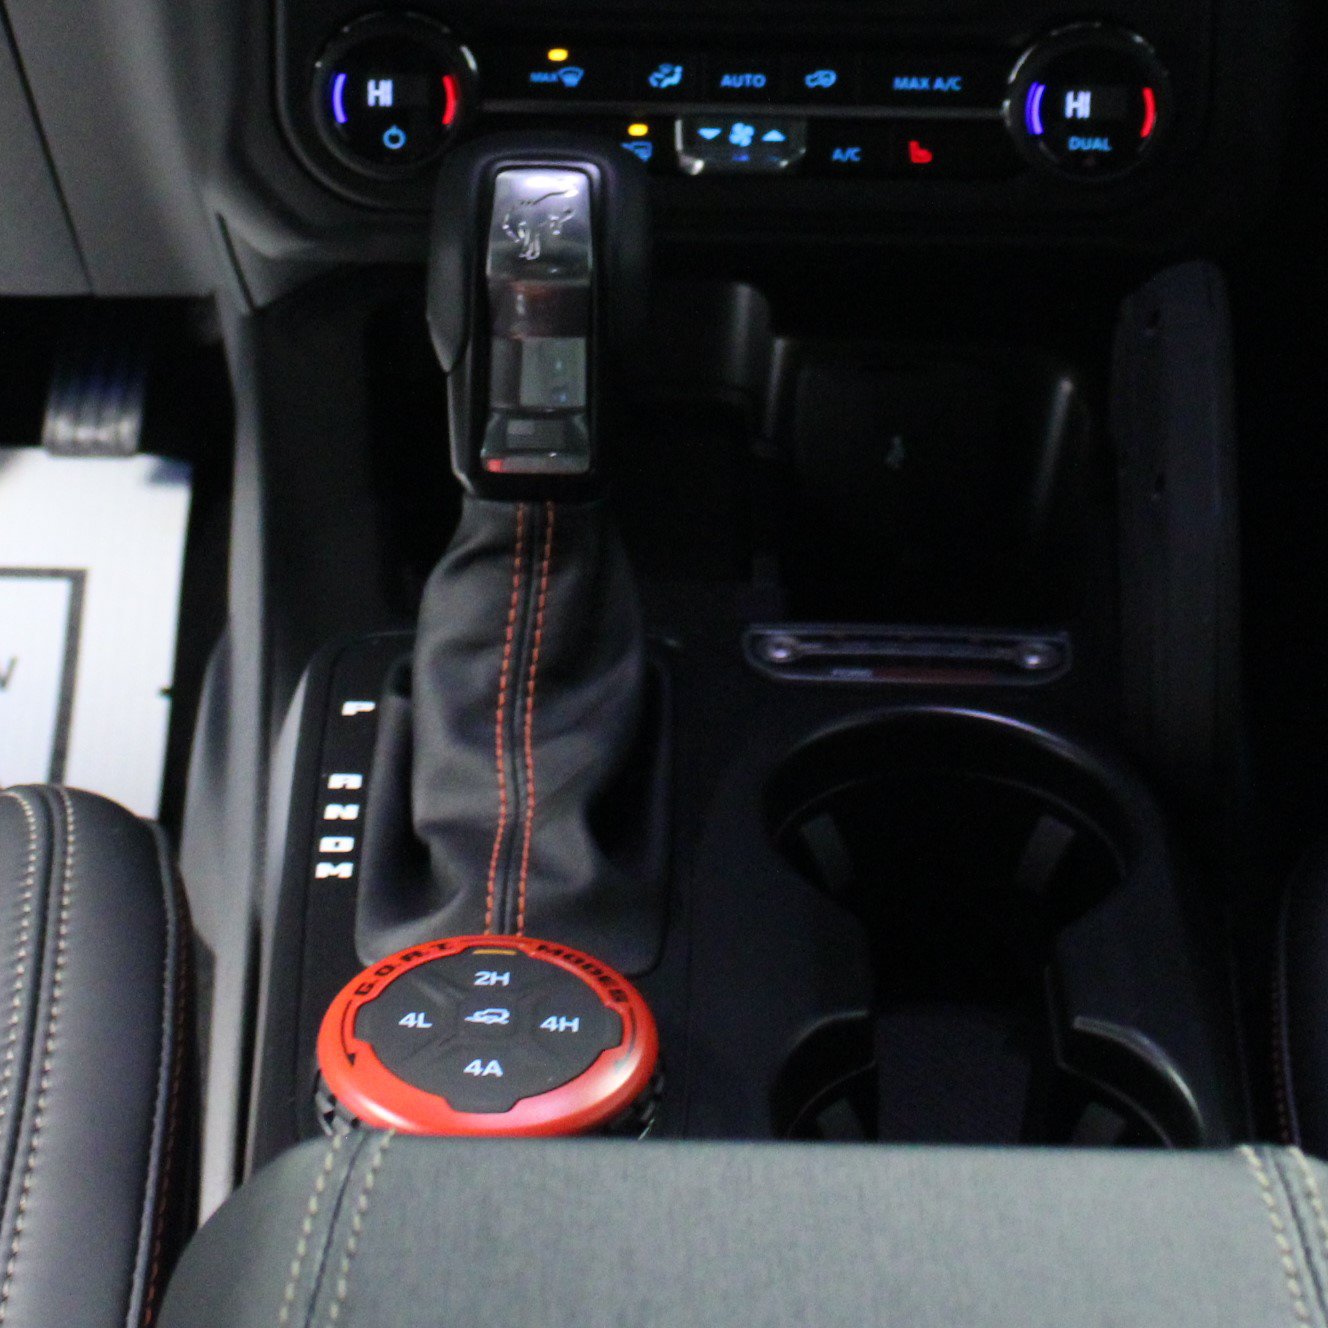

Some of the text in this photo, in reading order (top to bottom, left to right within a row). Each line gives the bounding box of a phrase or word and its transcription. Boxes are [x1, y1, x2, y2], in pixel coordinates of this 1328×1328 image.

[721, 74, 766, 89] AUTO
[893, 76, 962, 92] MAX A/C
[367, 79, 393, 107] HI
[1065, 91, 1092, 119] HI
[1068, 136, 1111, 152] DUAL
[832, 147, 862, 162] A/C
[324, 804, 360, 820] N
[319, 836, 355, 853] D
[314, 861, 354, 879] M
[474, 970, 511, 987] 2H
[536, 944, 629, 1003] MODES
[398, 1011, 433, 1029] 4L
[539, 1015, 580, 1033] 4H
[463, 1059, 504, 1077] 4A
